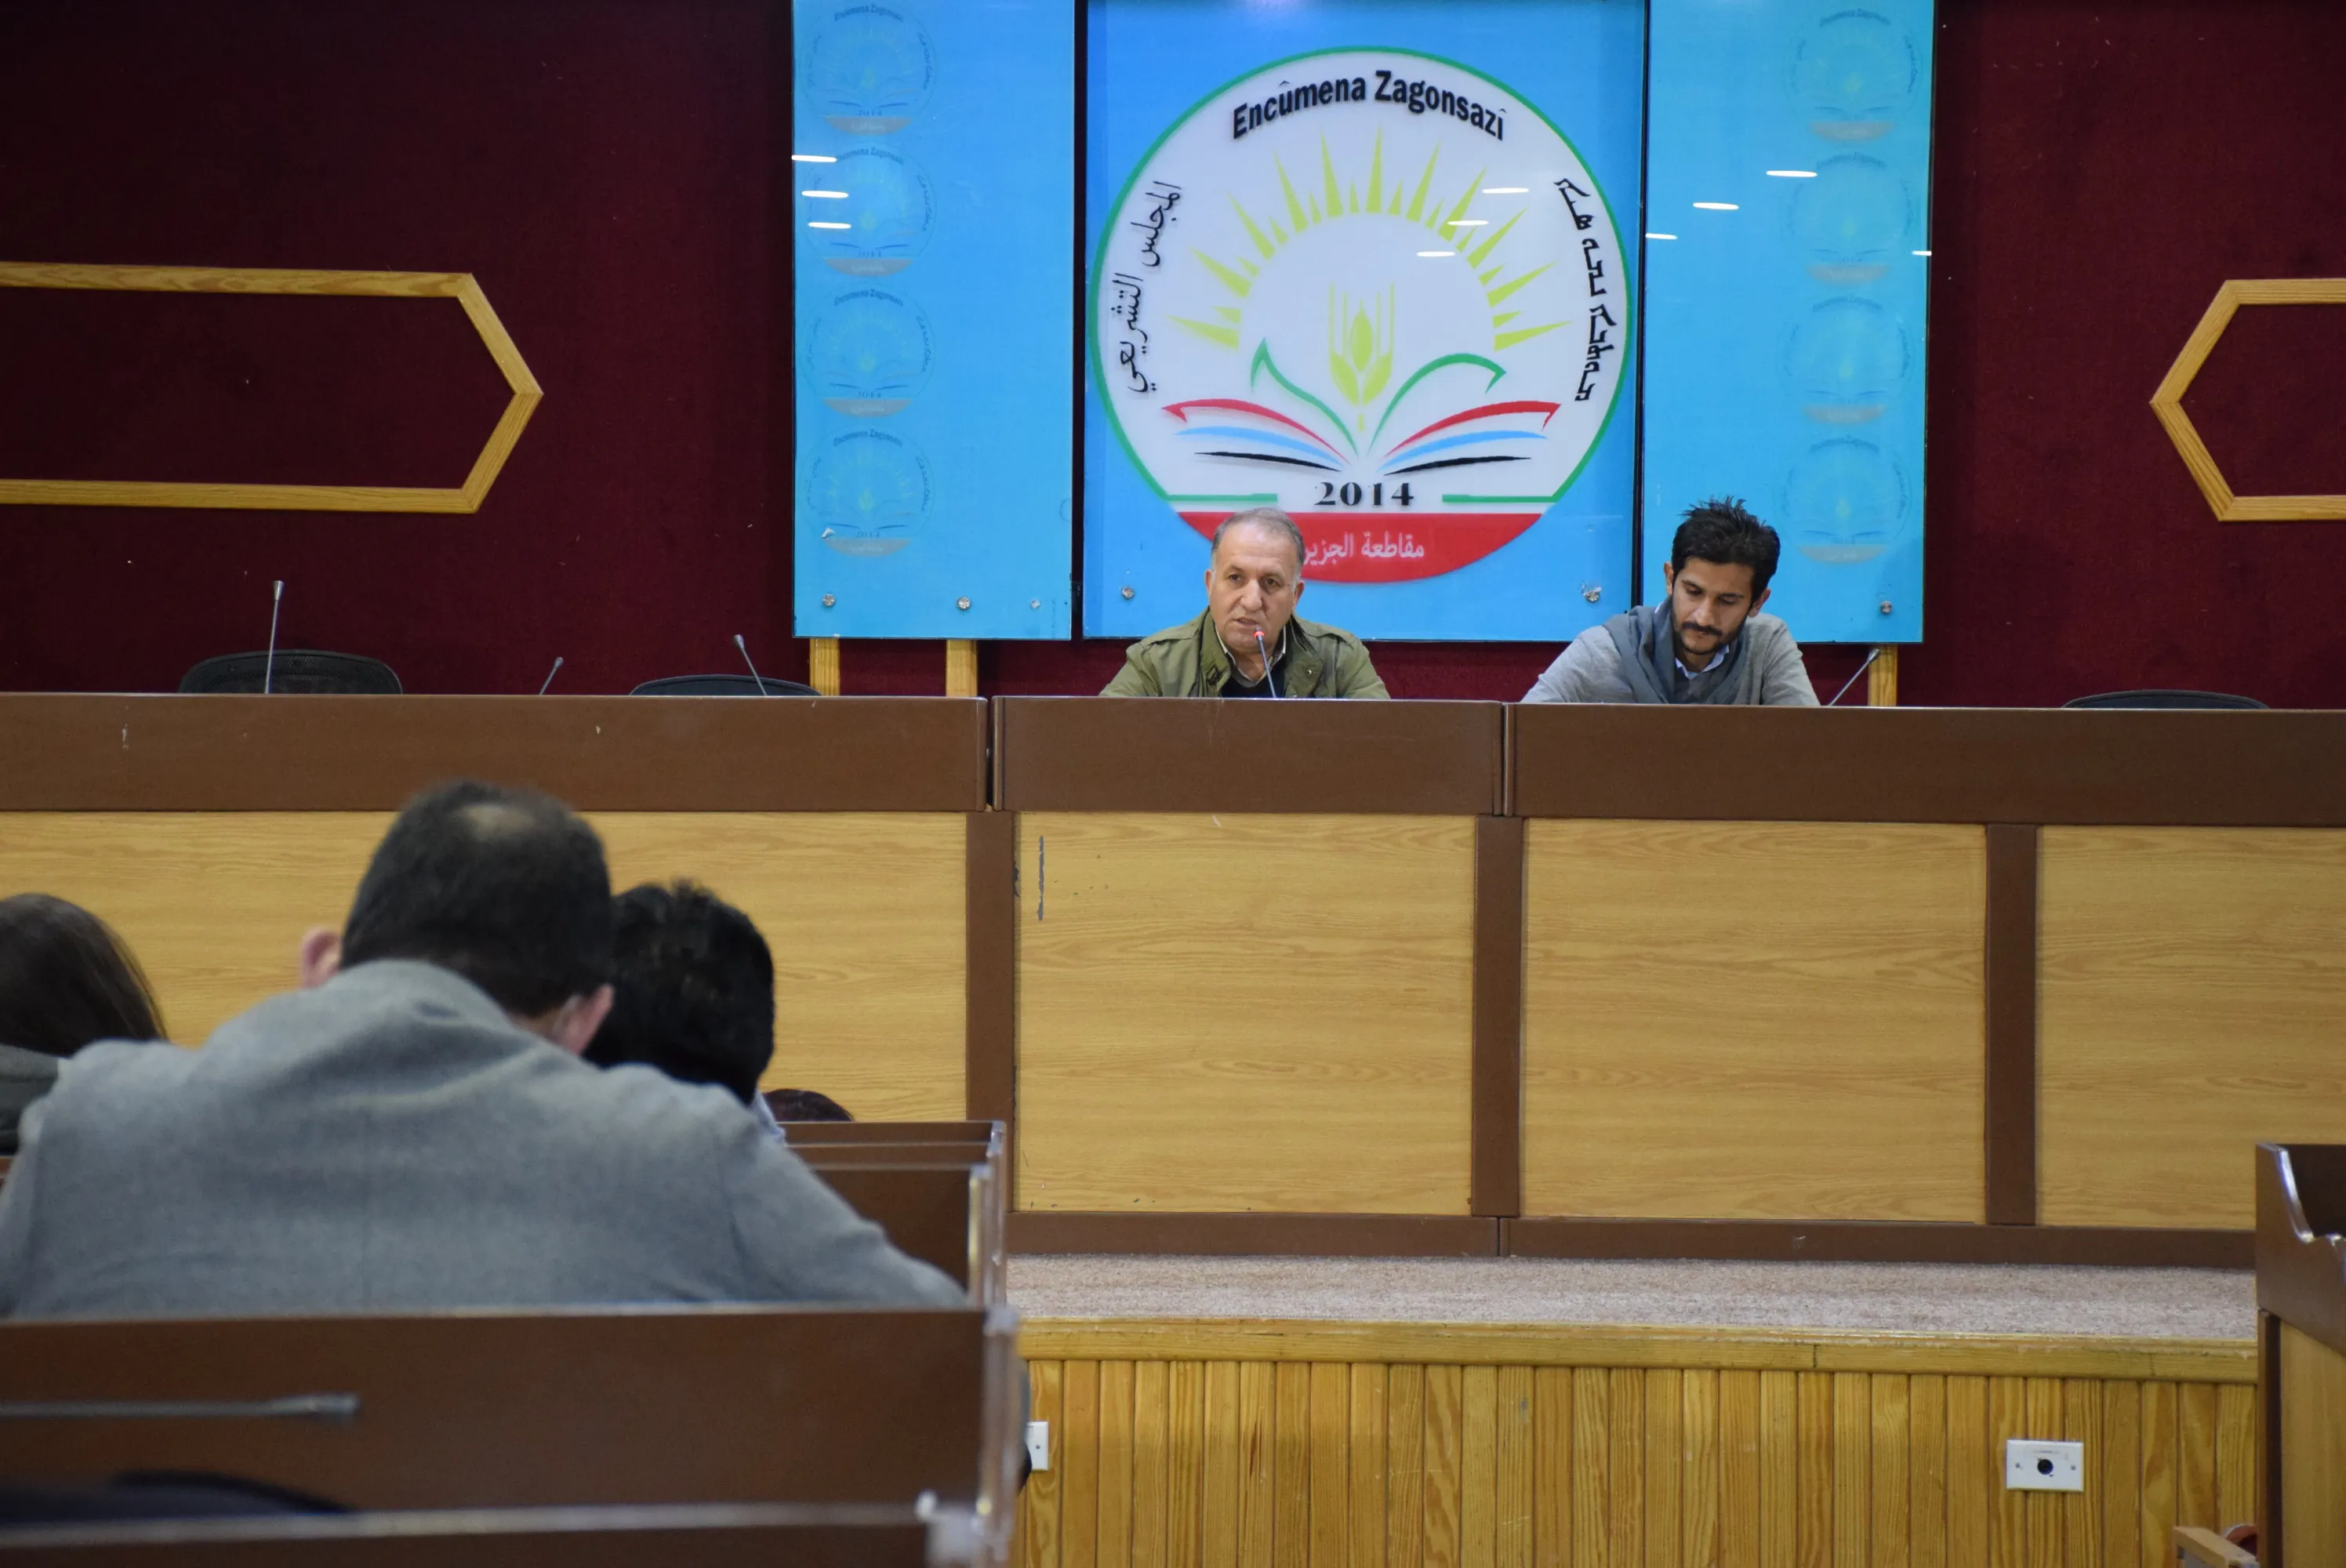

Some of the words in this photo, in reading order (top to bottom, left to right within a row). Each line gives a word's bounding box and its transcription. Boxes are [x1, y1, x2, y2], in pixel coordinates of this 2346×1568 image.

[1233, 77, 1366, 139] Encûmena
[1375, 70, 1507, 140] Zagonsazî
[1130, 180, 1182, 267] المجلس
[1111, 272, 1157, 393] التشريعي
[1314, 481, 1414, 506] 2014
[1303, 532, 1354, 566] الجزير
[1361, 531, 1425, 559] مقاطعة
